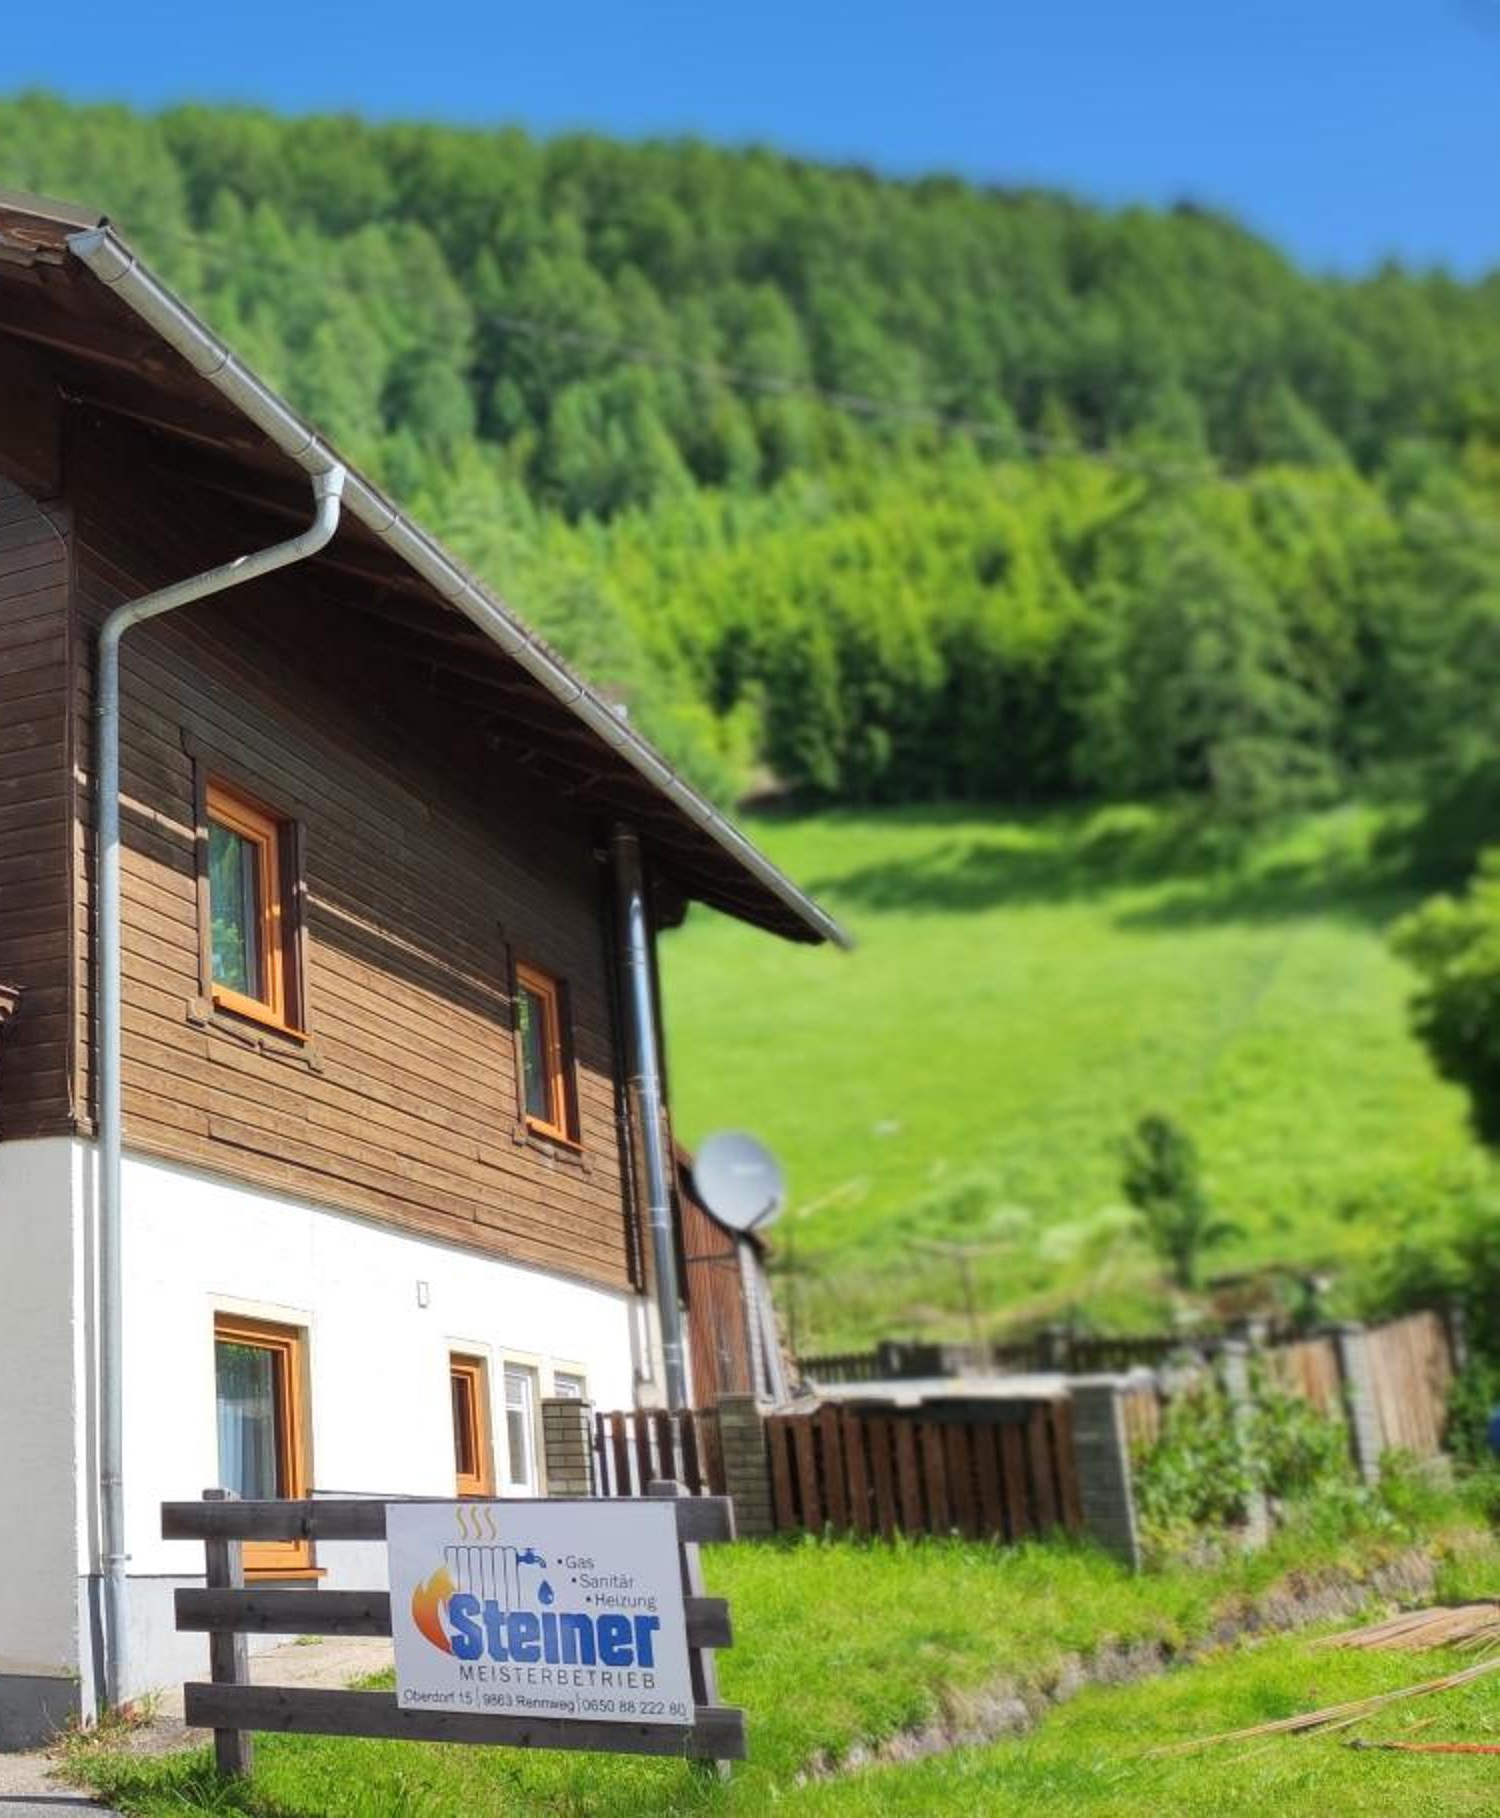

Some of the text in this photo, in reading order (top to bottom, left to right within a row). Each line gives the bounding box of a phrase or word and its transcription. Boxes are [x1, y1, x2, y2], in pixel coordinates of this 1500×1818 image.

[565, 1555, 595, 1569] Gas
[579, 1573, 634, 1589] Sanitär
[594, 1594, 657, 1613] Heizung
[450, 1593, 660, 1668] Steiner
[459, 1664, 656, 1689] MEISTERBETRIEB
[403, 1688, 455, 1703] Oberdorf
[459, 1690, 474, 1705] 15
[516, 1695, 575, 1713] Rennweg
[581, 1699, 615, 1713] 0650
[640, 1701, 665, 1715] 222
